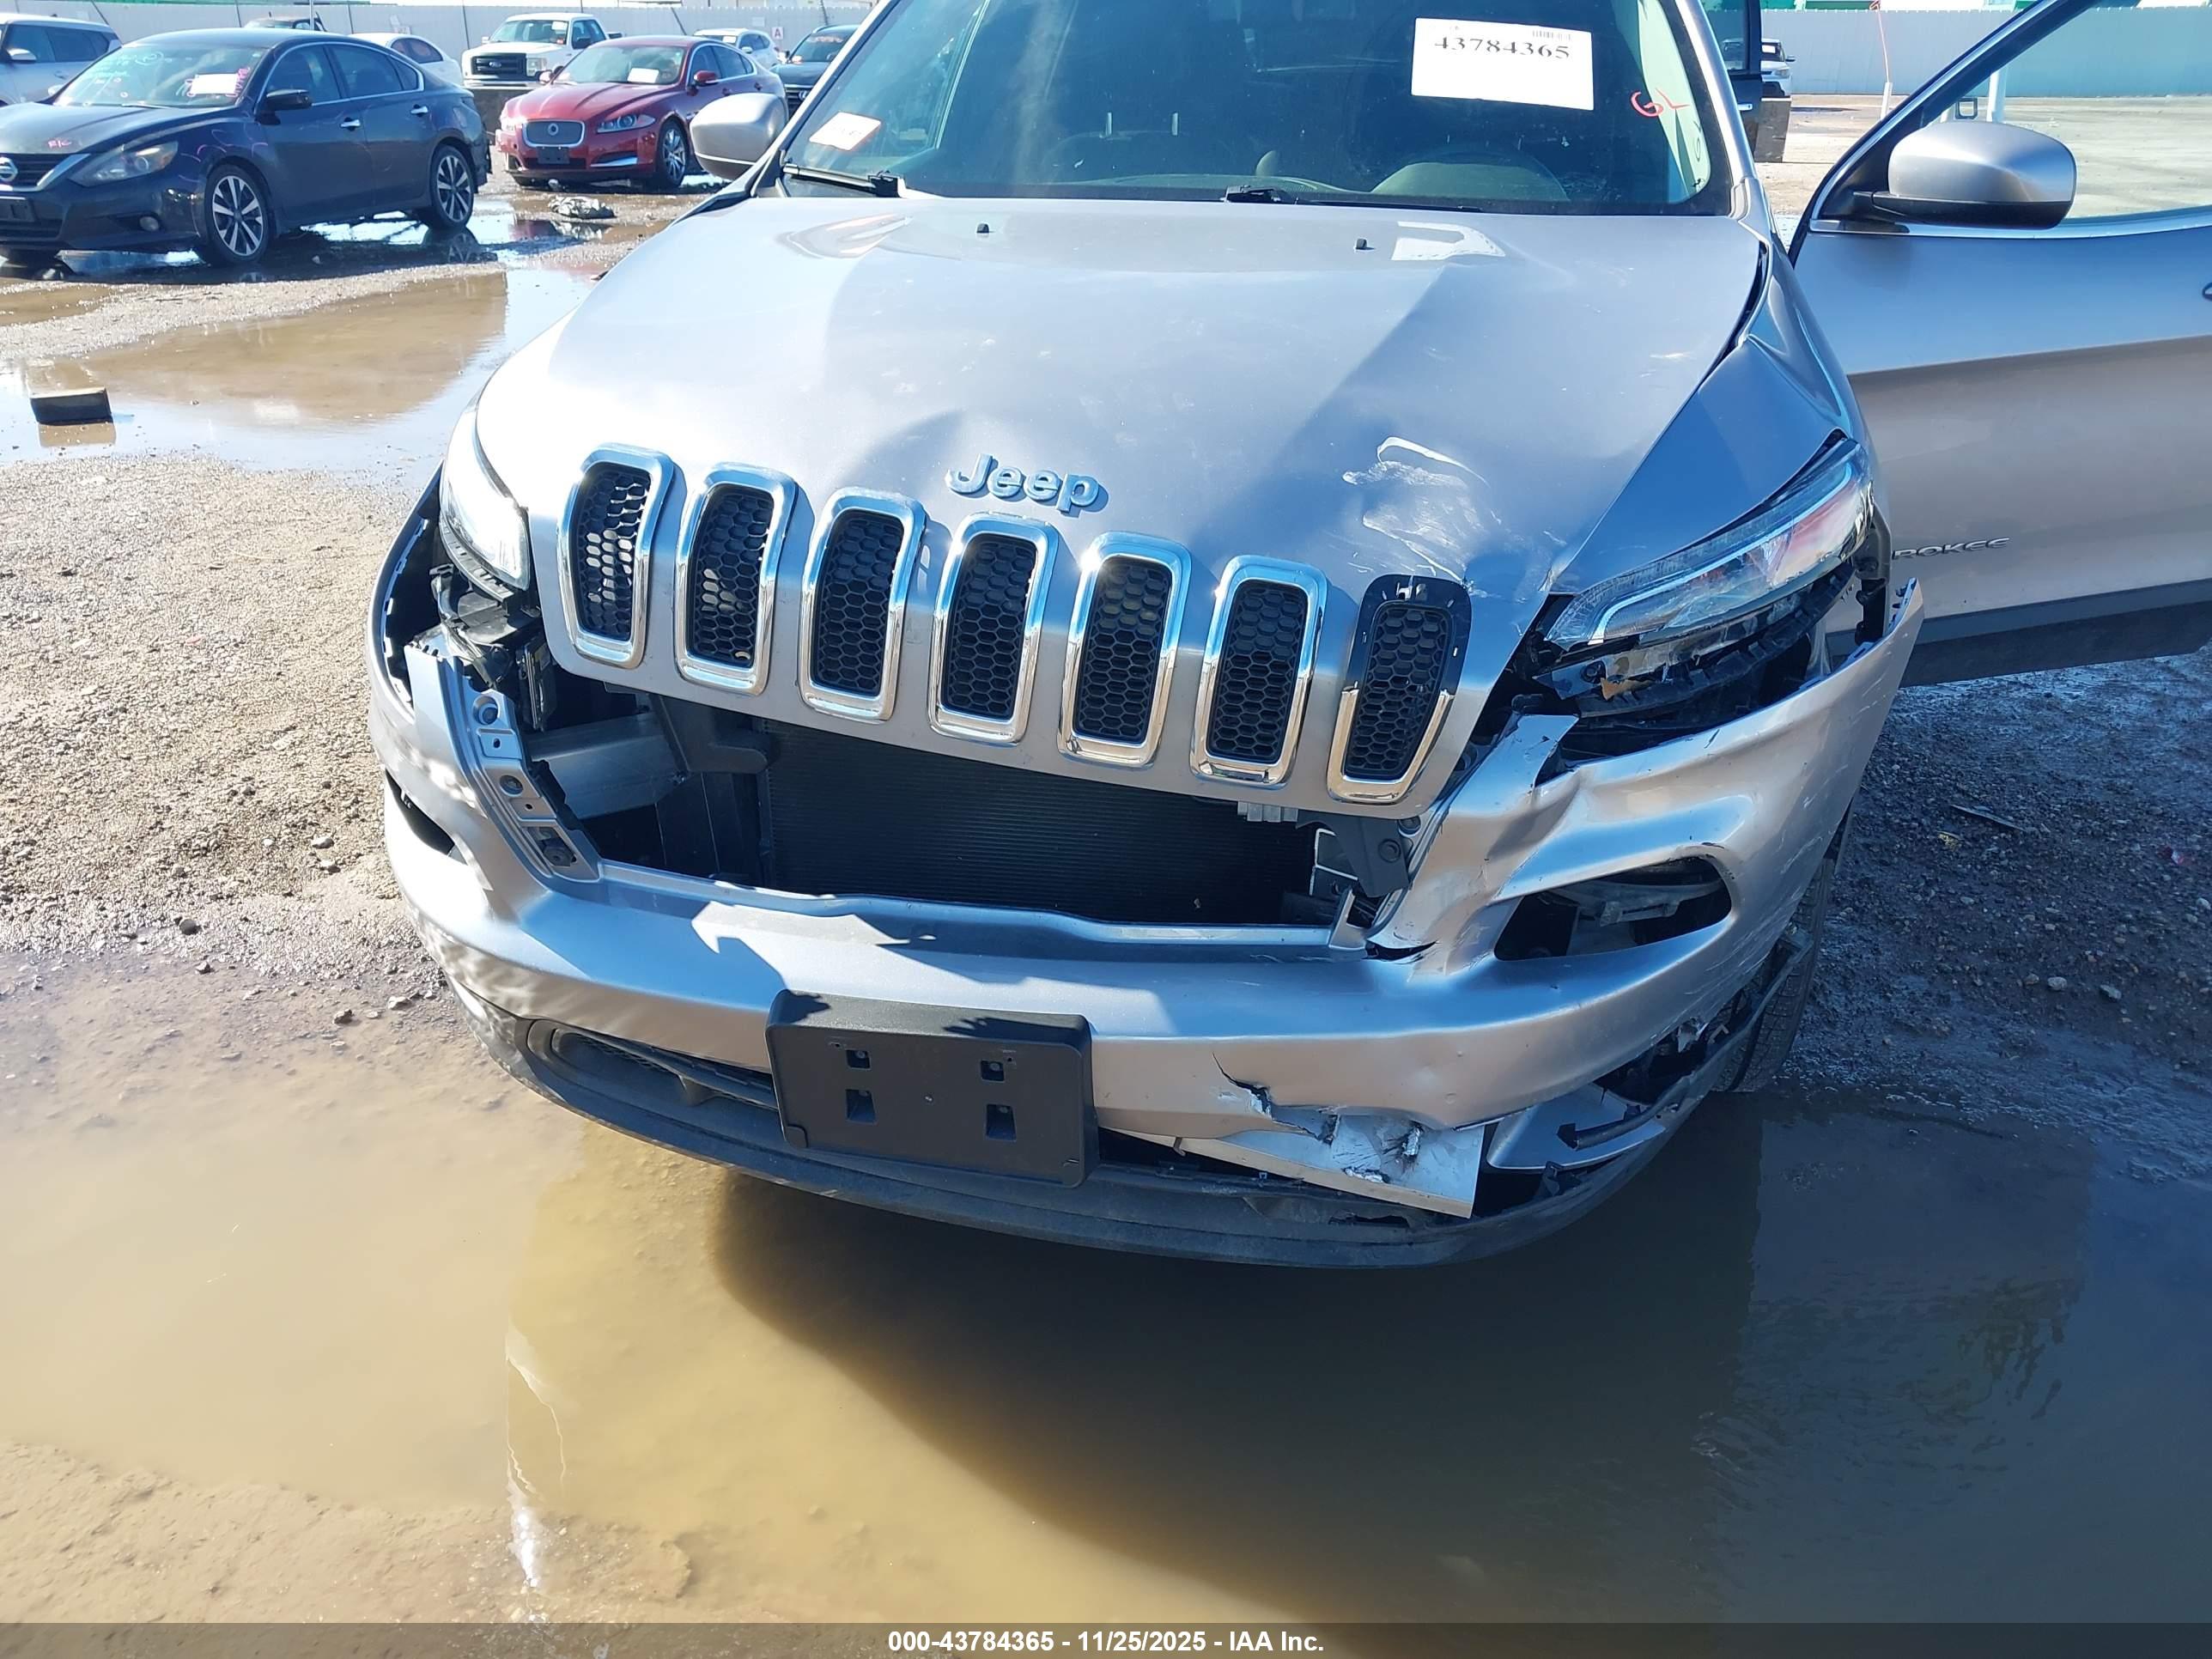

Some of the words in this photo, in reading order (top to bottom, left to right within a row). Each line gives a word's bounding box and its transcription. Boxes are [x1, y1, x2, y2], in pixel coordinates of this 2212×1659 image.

[1434, 36, 1571, 59] 43784365
[945, 453, 1101, 514] Jeep
[1892, 537, 2010, 561] ROKEE
